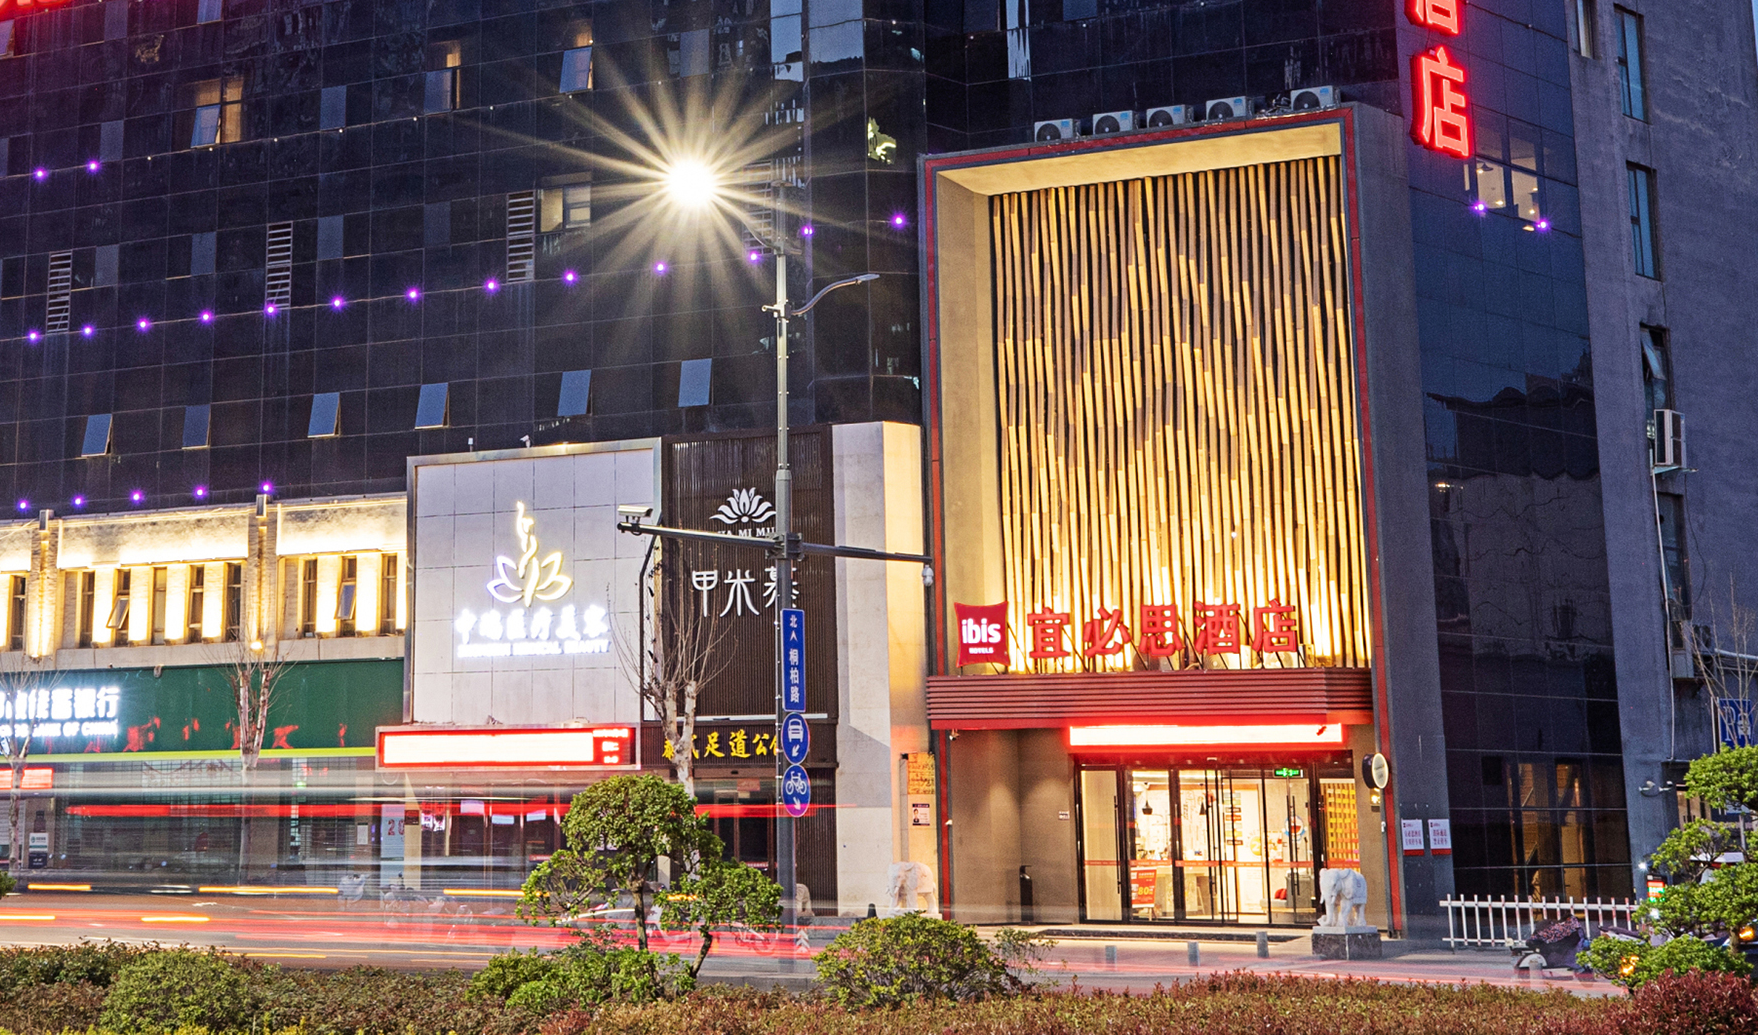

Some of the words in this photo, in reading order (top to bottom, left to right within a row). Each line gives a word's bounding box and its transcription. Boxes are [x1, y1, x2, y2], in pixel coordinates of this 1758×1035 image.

[789, 614, 798, 628] 北
[961, 617, 1002, 644] ibis
[1026, 598, 1298, 659] 宜必思酒店
[788, 648, 800, 703] 桐柏路
